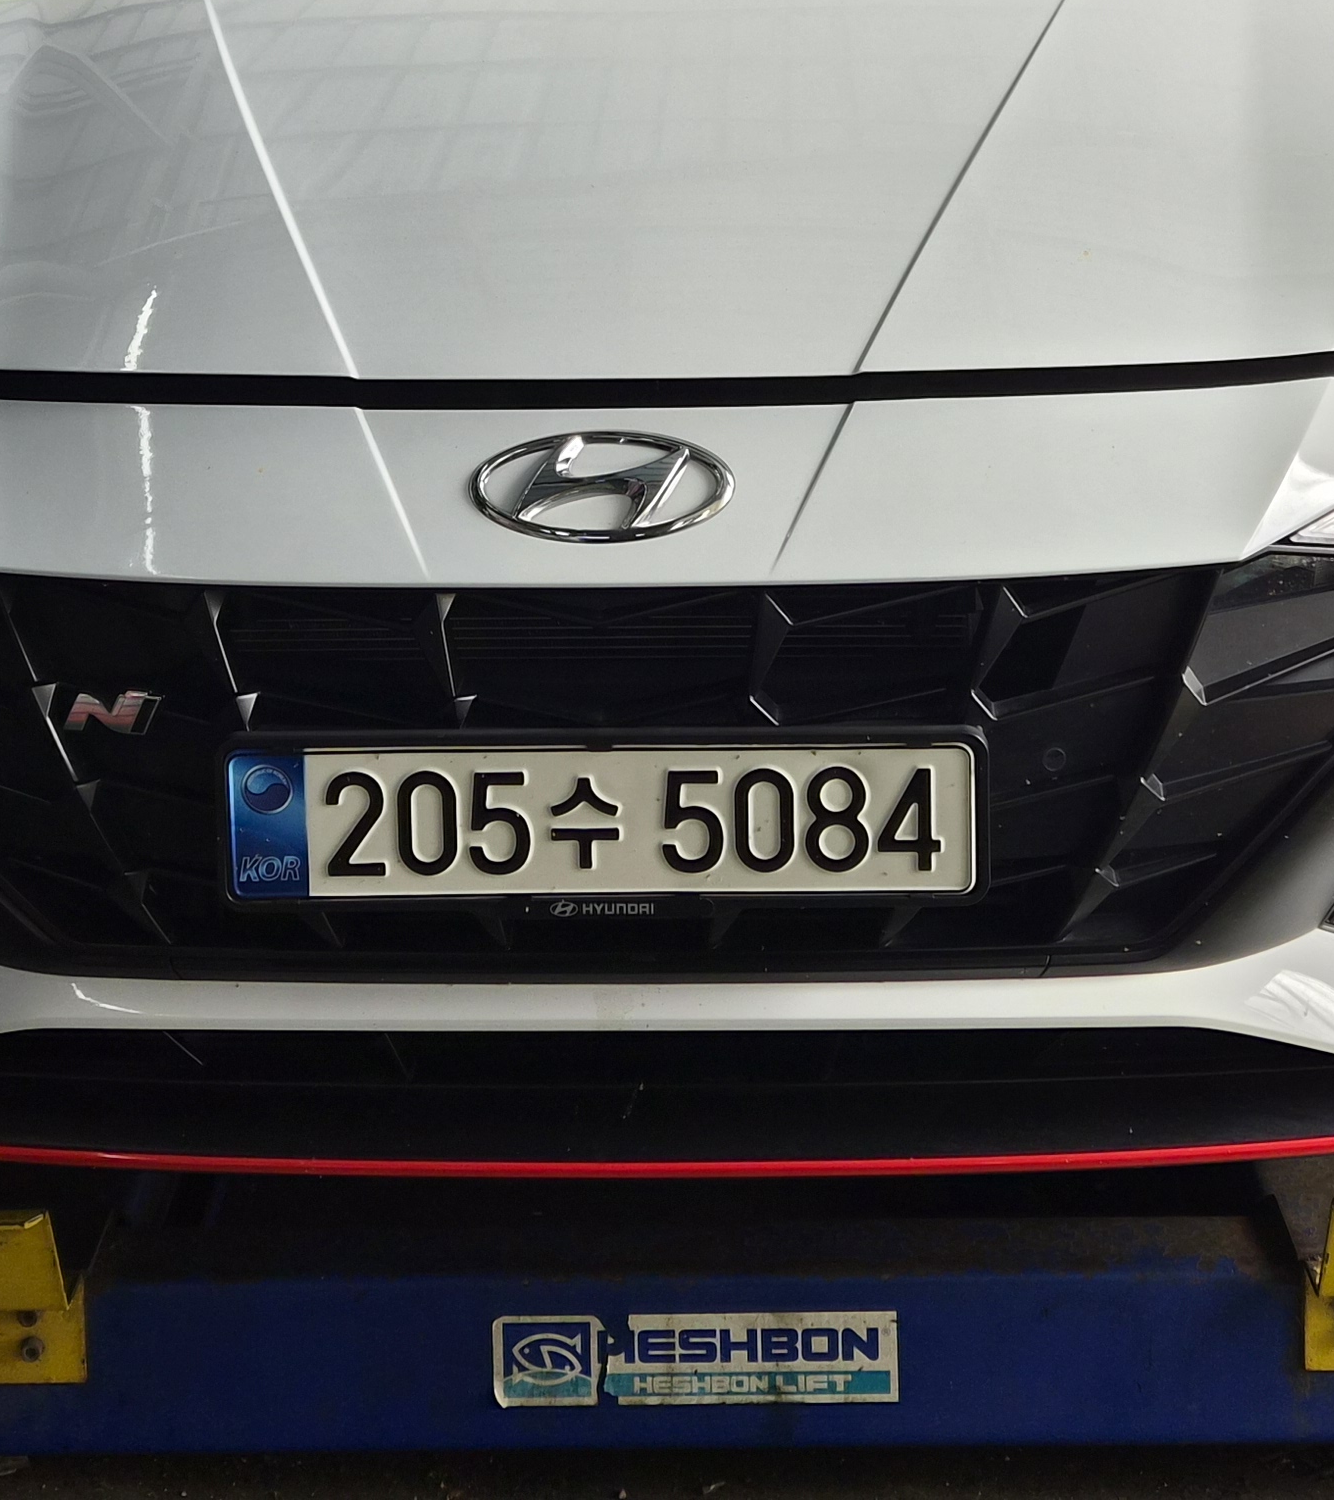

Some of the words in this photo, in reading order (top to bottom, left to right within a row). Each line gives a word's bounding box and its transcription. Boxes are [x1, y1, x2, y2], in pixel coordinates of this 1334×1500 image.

[63, 689, 162, 735] N
[325, 770, 621, 877] 205수
[661, 765, 942, 874] 5084
[239, 854, 301, 882] KOR
[582, 902, 655, 915] HYUNDAI
[633, 1374, 769, 1395] HESHBON
[775, 1373, 852, 1393] LIFT
